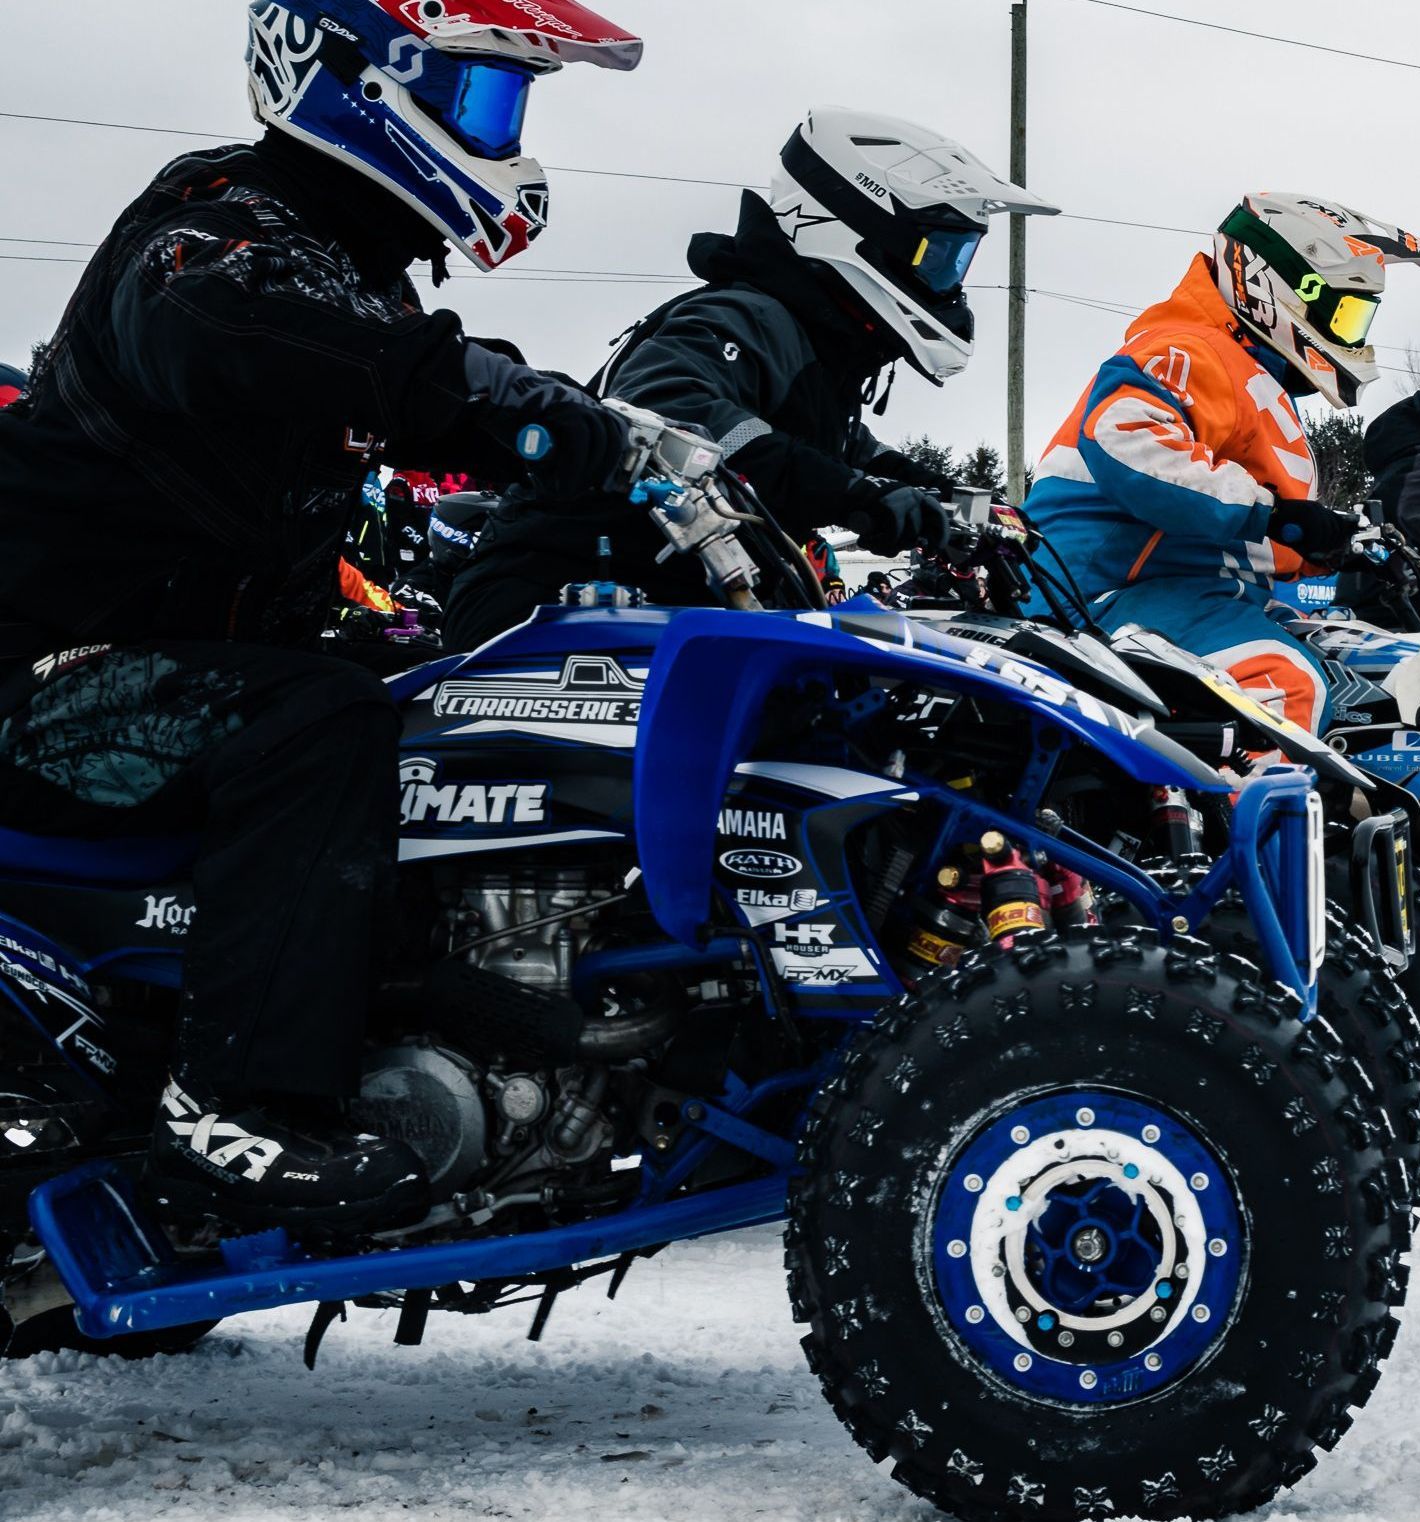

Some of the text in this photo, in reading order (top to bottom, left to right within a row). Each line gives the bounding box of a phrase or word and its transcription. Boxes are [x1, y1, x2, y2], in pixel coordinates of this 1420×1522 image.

[57, 643, 112, 666] RECON
[445, 696, 621, 722] CARROSSERIE
[717, 809, 786, 840] AMAHA
[727, 854, 794, 869] RATH
[736, 888, 790, 908] Elka
[785, 944, 829, 955] HOUSER
[282, 1171, 321, 1182] FXR
